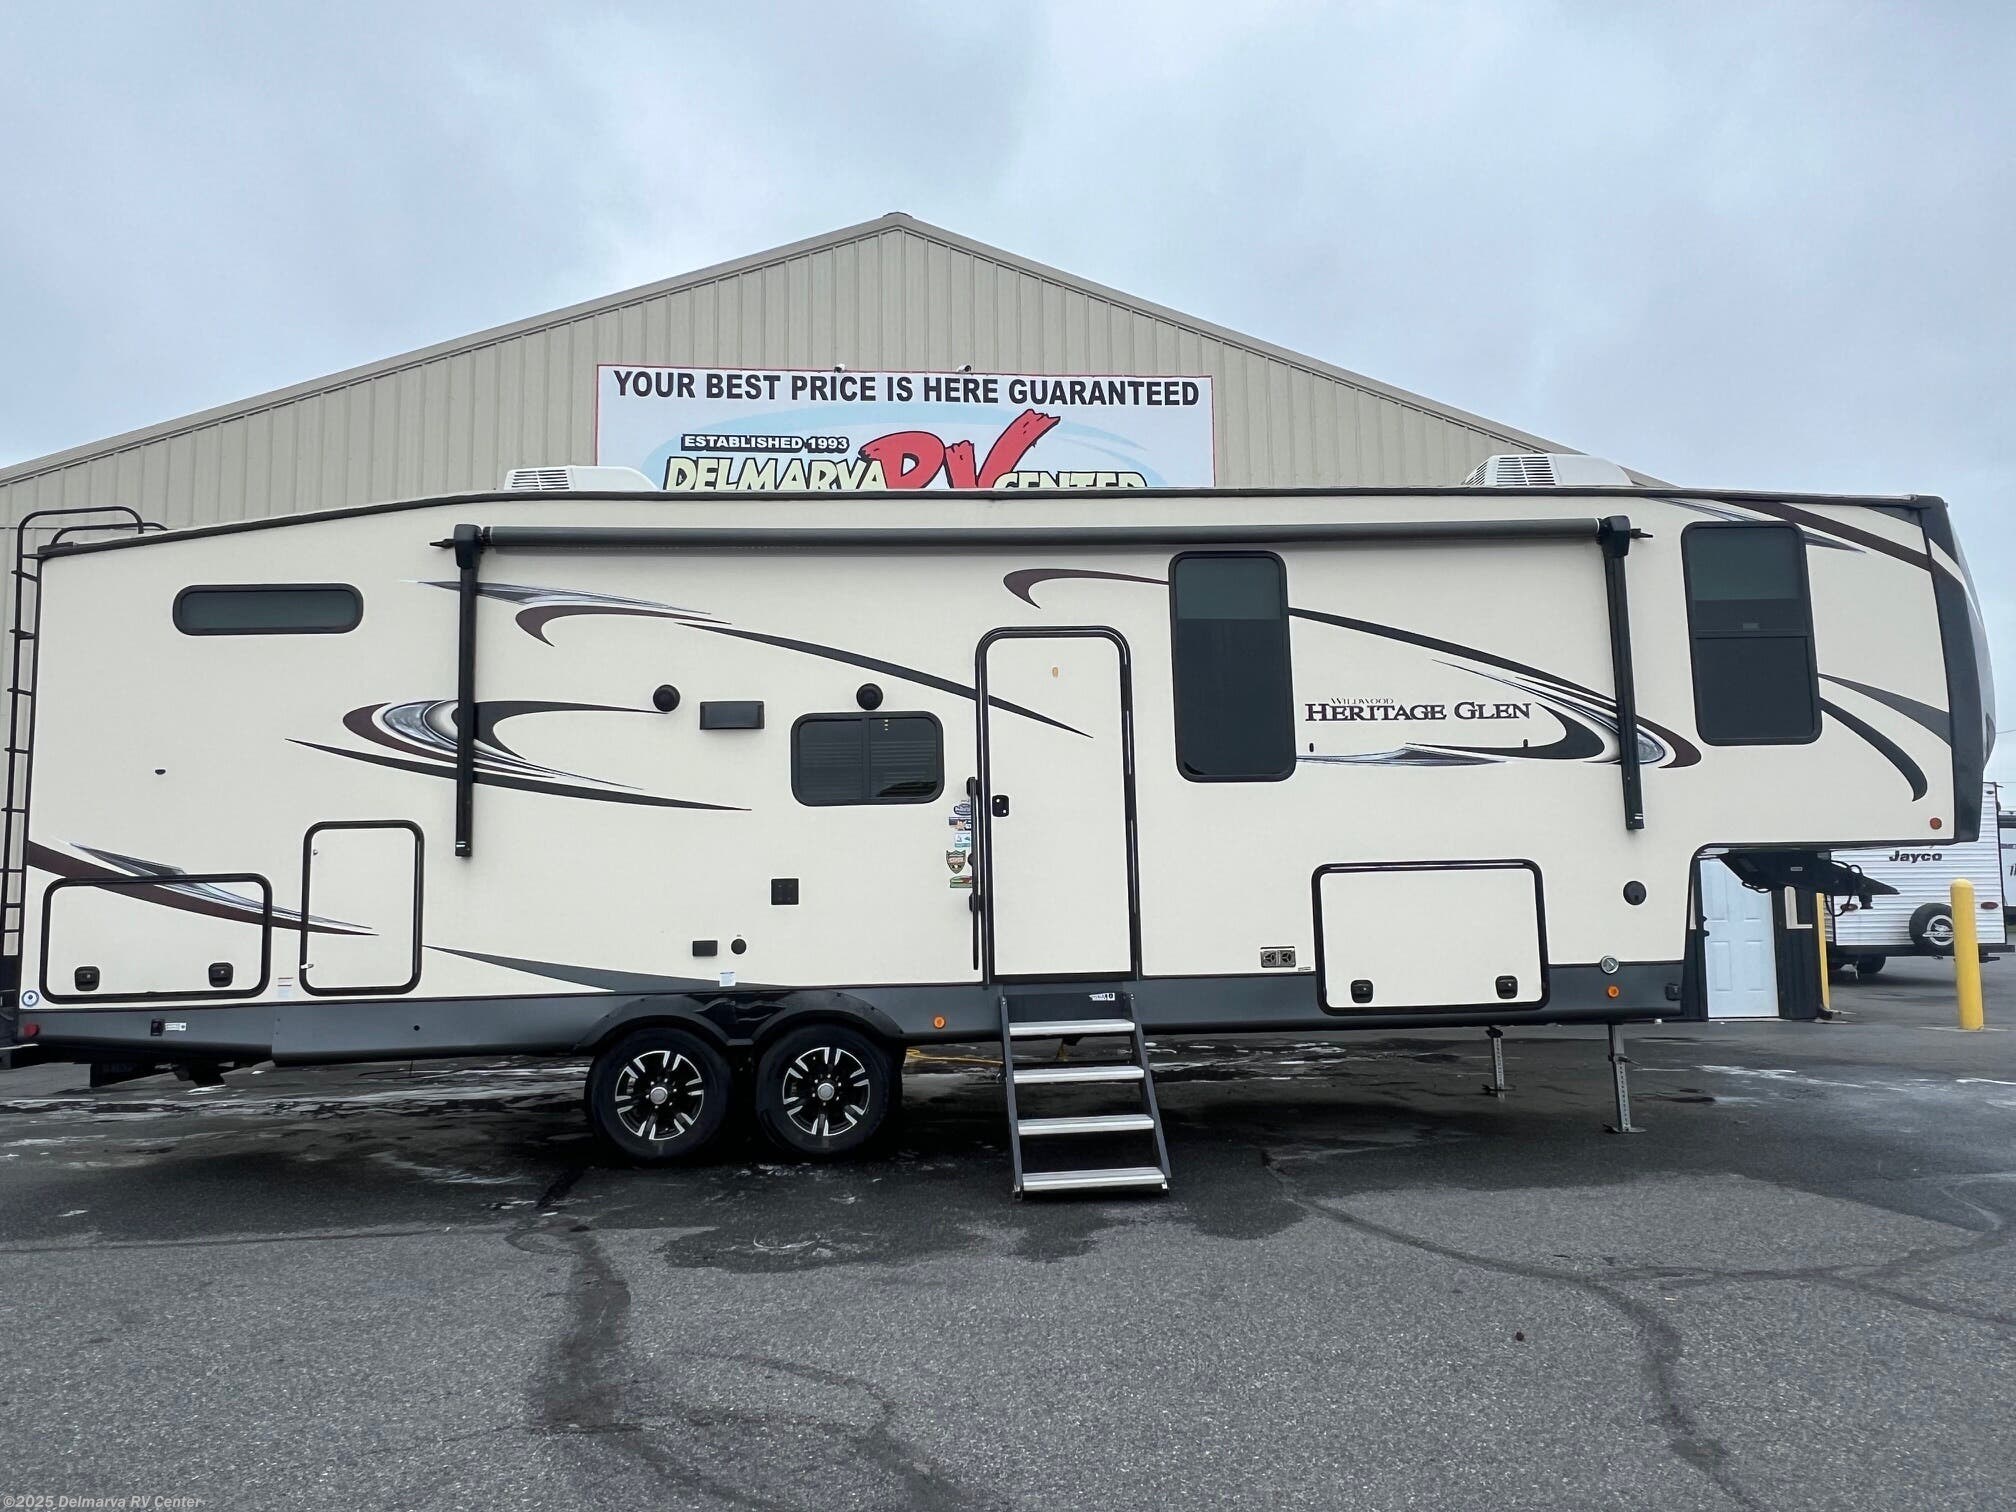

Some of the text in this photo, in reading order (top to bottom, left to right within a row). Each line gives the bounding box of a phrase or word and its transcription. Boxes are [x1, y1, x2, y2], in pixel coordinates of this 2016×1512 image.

[614, 370, 1199, 406] YOUR BEST PRICE IS HERE GUARANTEED
[664, 456, 888, 490] DELMARVA
[858, 409, 1061, 488] RV
[683, 435, 848, 450] ESTABLISHED 1993
[1305, 702, 1531, 721] HERITAGE GLEN
[1889, 850, 1943, 863] Jayco
